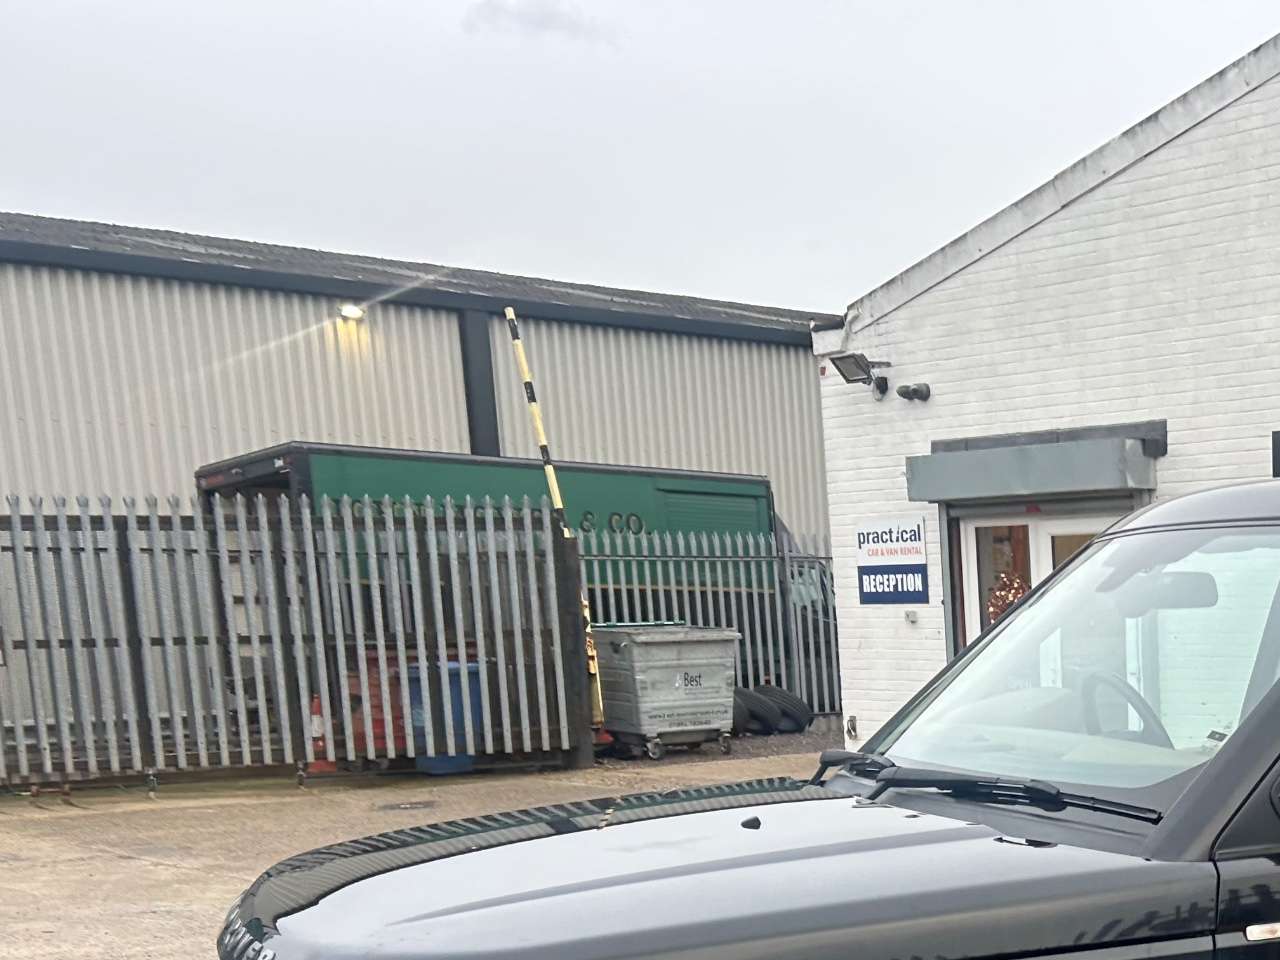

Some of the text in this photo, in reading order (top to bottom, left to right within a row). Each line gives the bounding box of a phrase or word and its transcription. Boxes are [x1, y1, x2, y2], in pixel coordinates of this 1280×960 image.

[857, 523, 921, 549] practical
[867, 548, 879, 557] CAR
[886, 547, 898, 556] VAN
[900, 546, 922, 556] RENTAL
[862, 573, 923, 593] RECEPTION
[684, 672, 702, 687] Best
